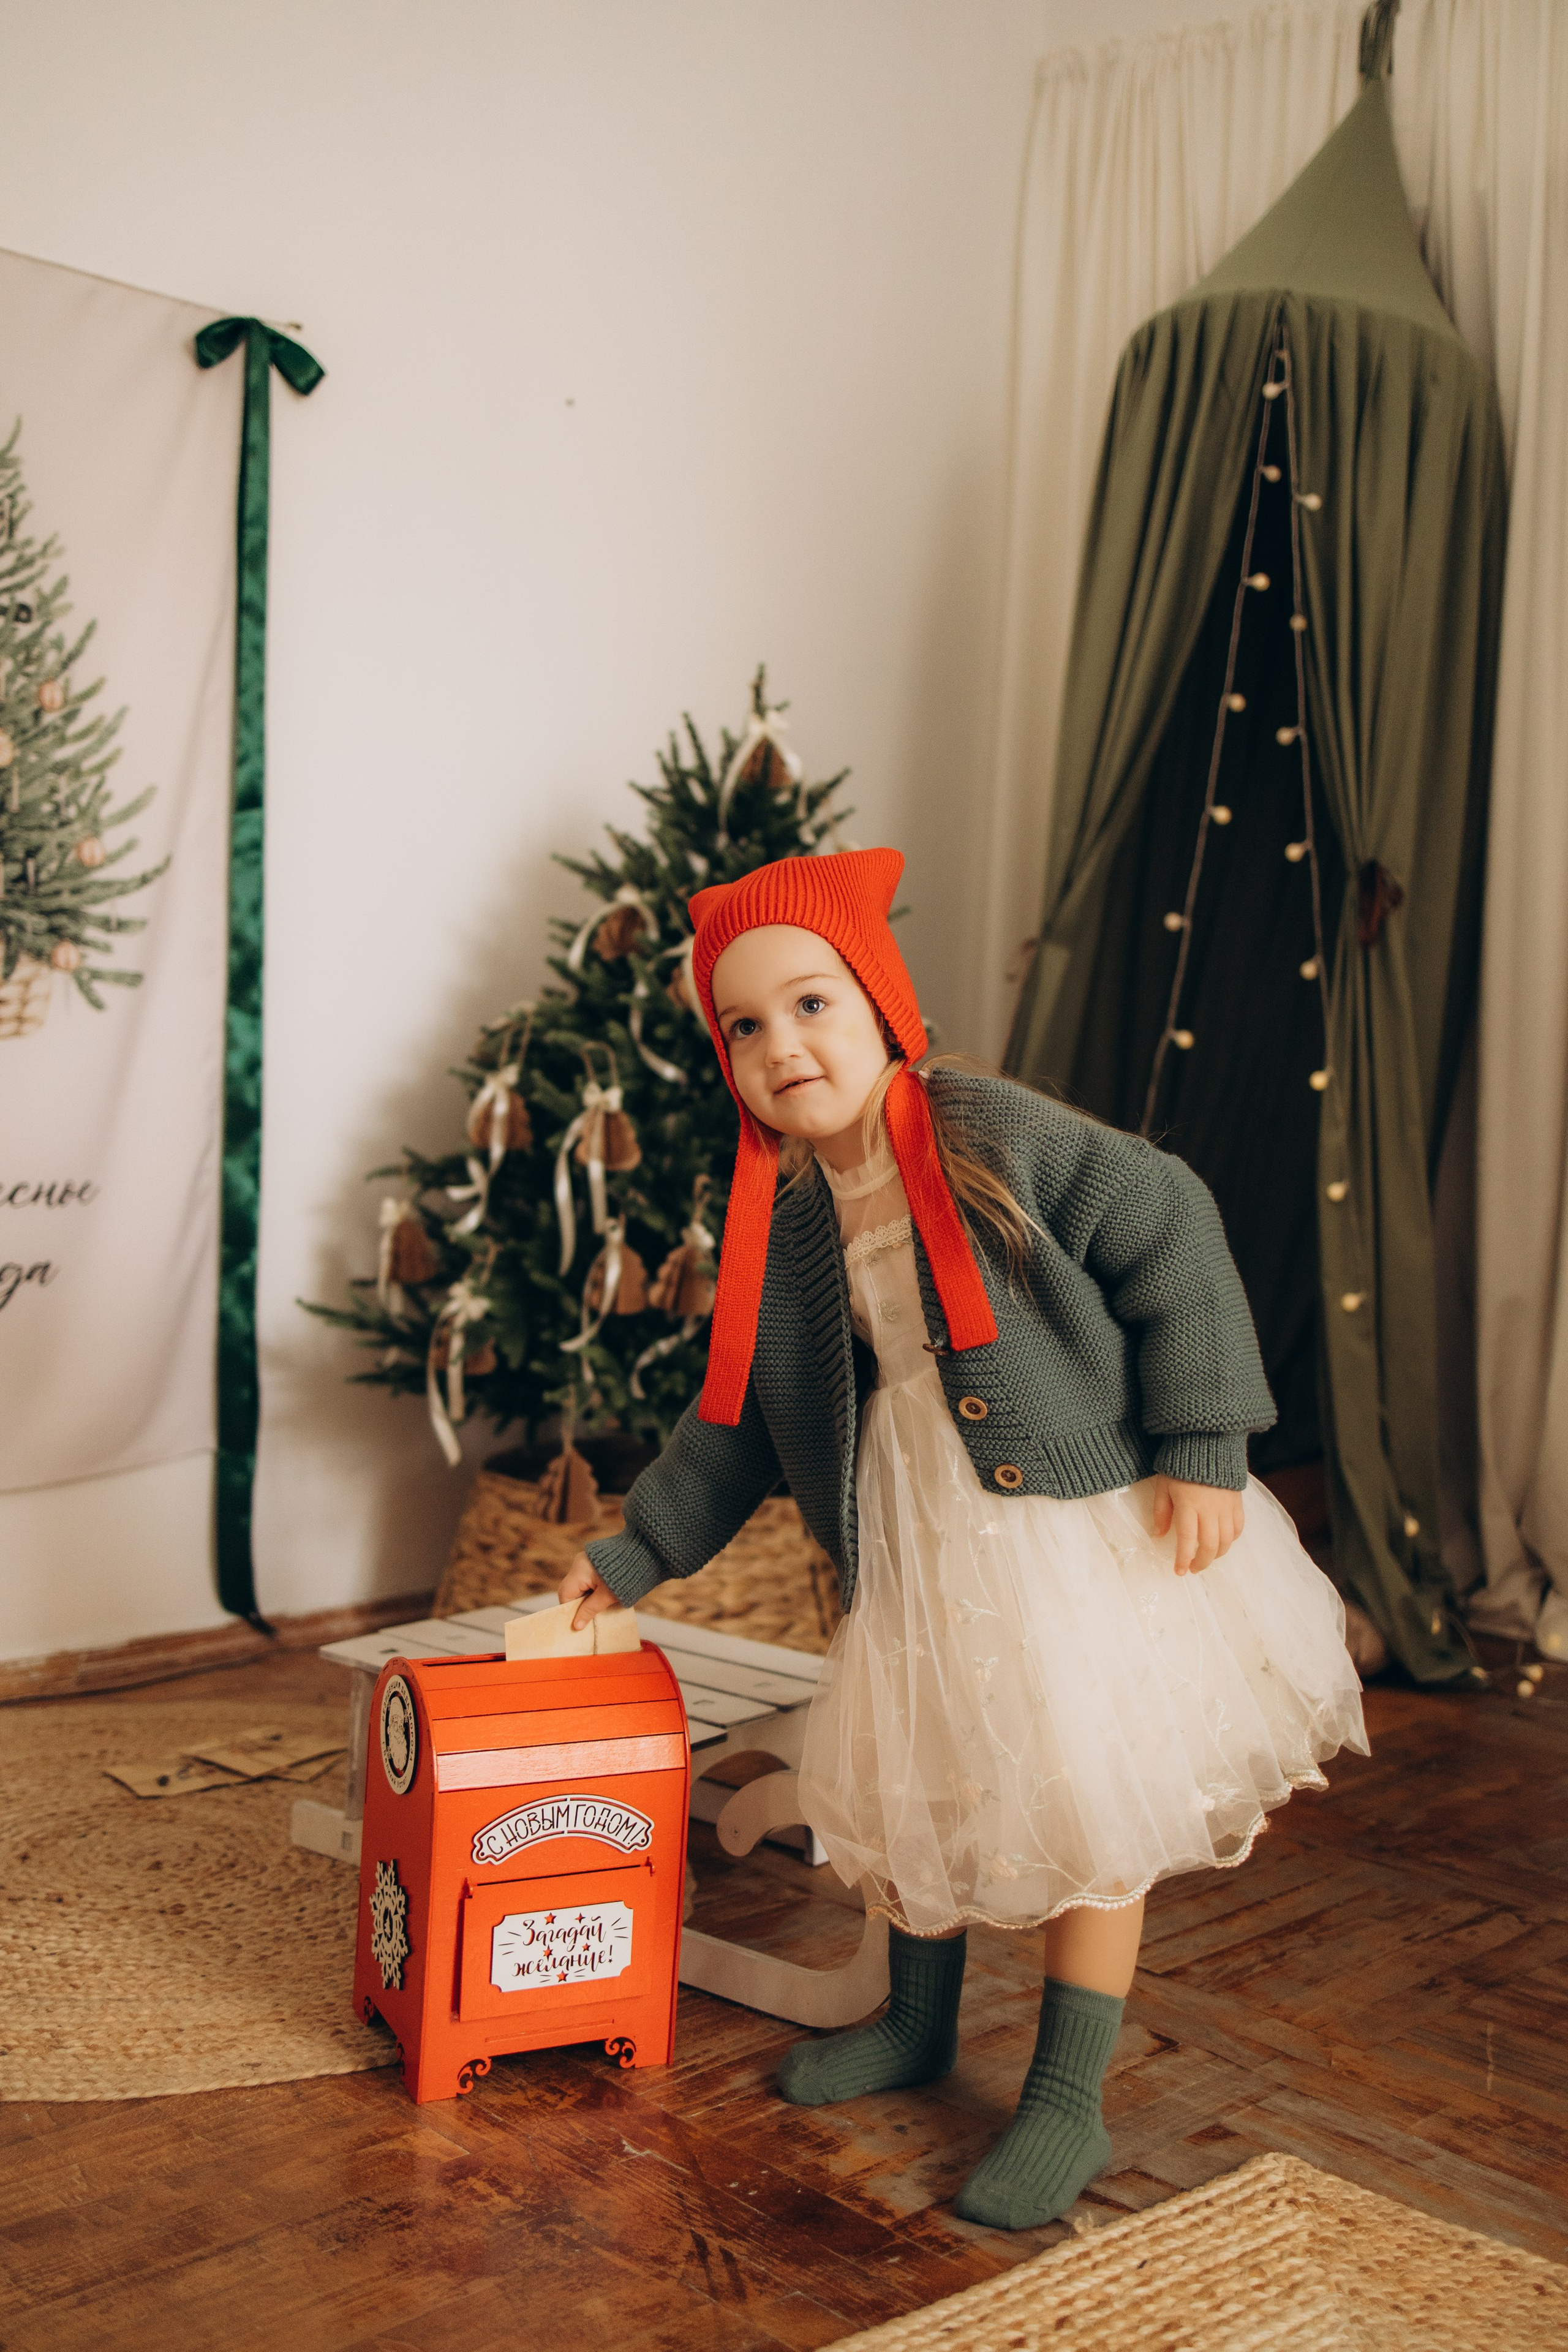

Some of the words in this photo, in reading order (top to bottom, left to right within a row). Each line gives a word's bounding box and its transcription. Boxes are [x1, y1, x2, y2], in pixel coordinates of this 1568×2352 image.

[0, 1179, 100, 1210] сню
[487, 1836, 503, 1855] С
[500, 1804, 570, 1847] НОВЫМ
[574, 1804, 645, 1845] ГОДОМ!
[522, 1916, 606, 1952] Загадай
[512, 1945, 613, 1977] желание!
